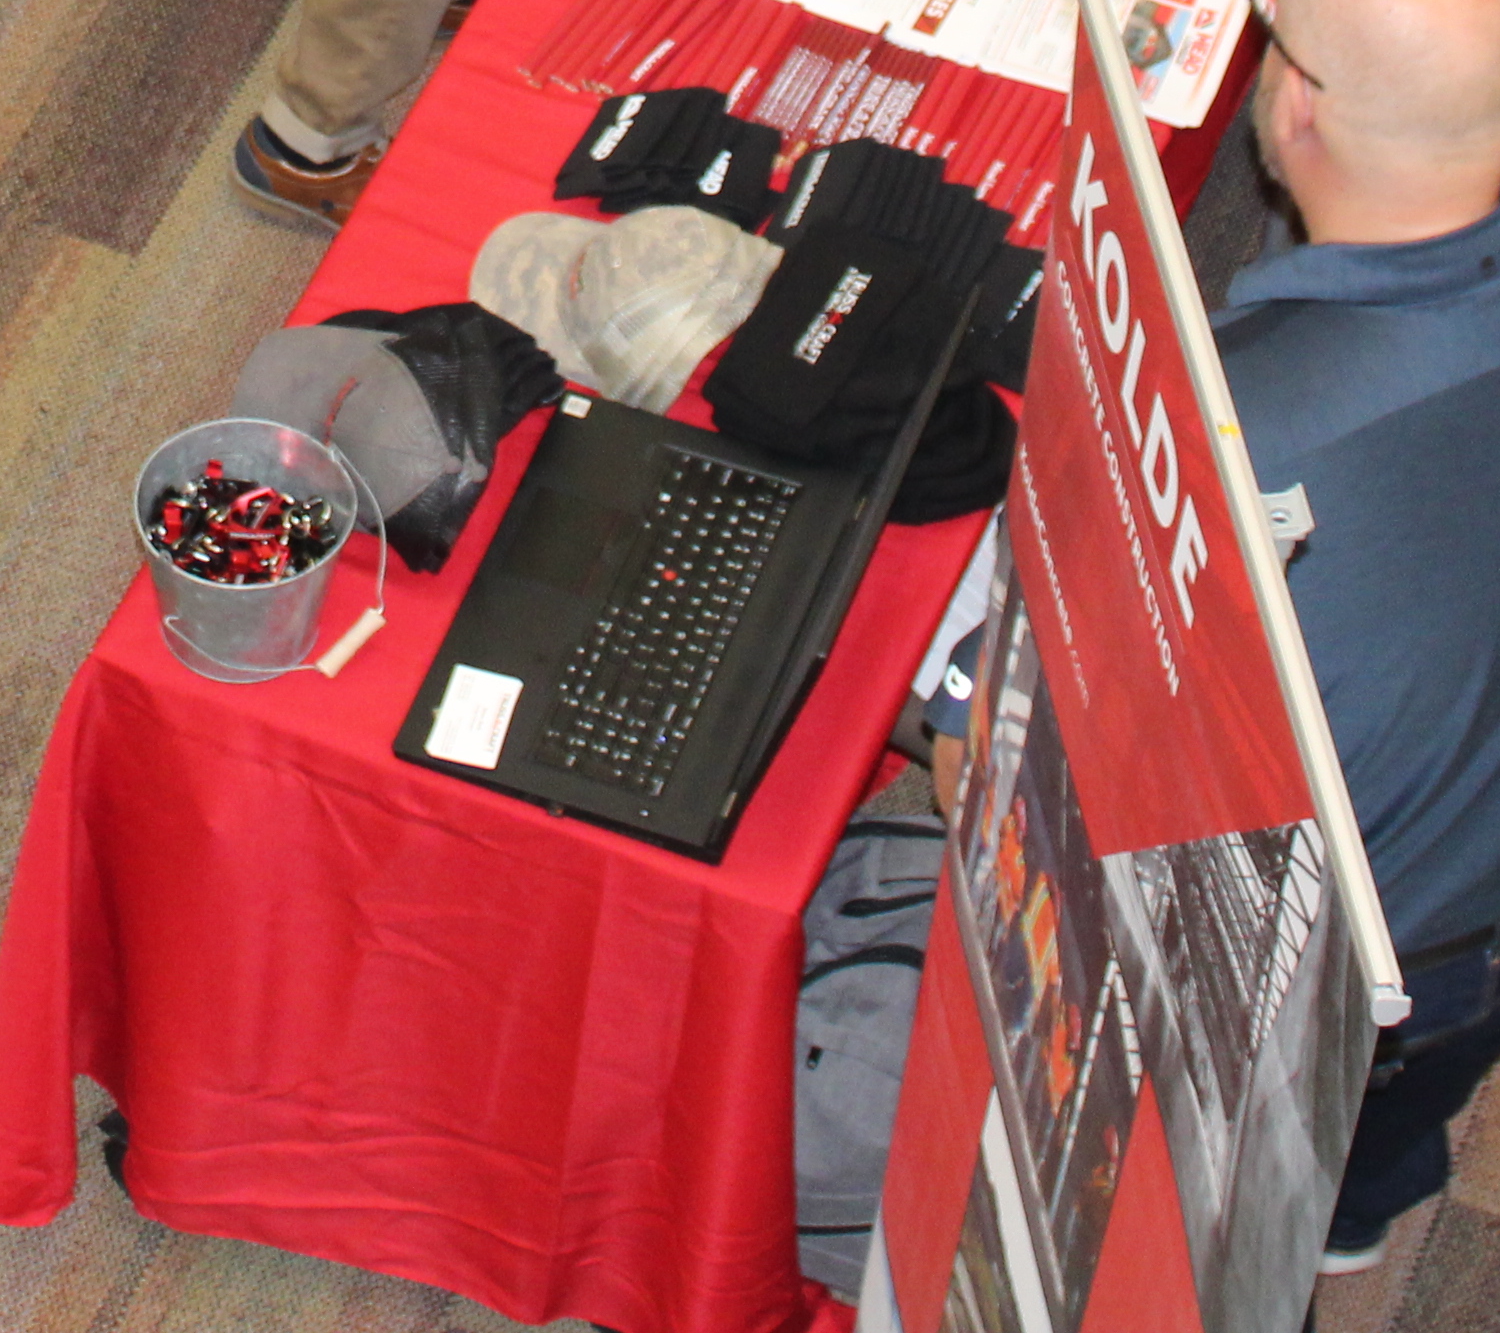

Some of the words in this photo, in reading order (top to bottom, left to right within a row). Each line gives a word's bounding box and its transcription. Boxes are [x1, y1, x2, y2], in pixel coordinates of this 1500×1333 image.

[1181, 28, 1208, 79] MEAD
[803, 322, 838, 365] CRAFT
[837, 273, 873, 315] TRUSS
[1056, 260, 1105, 432] CONCRETE
[1070, 132, 1209, 630] KOLDE
[1101, 431, 1181, 698] CONSTRUCTION
